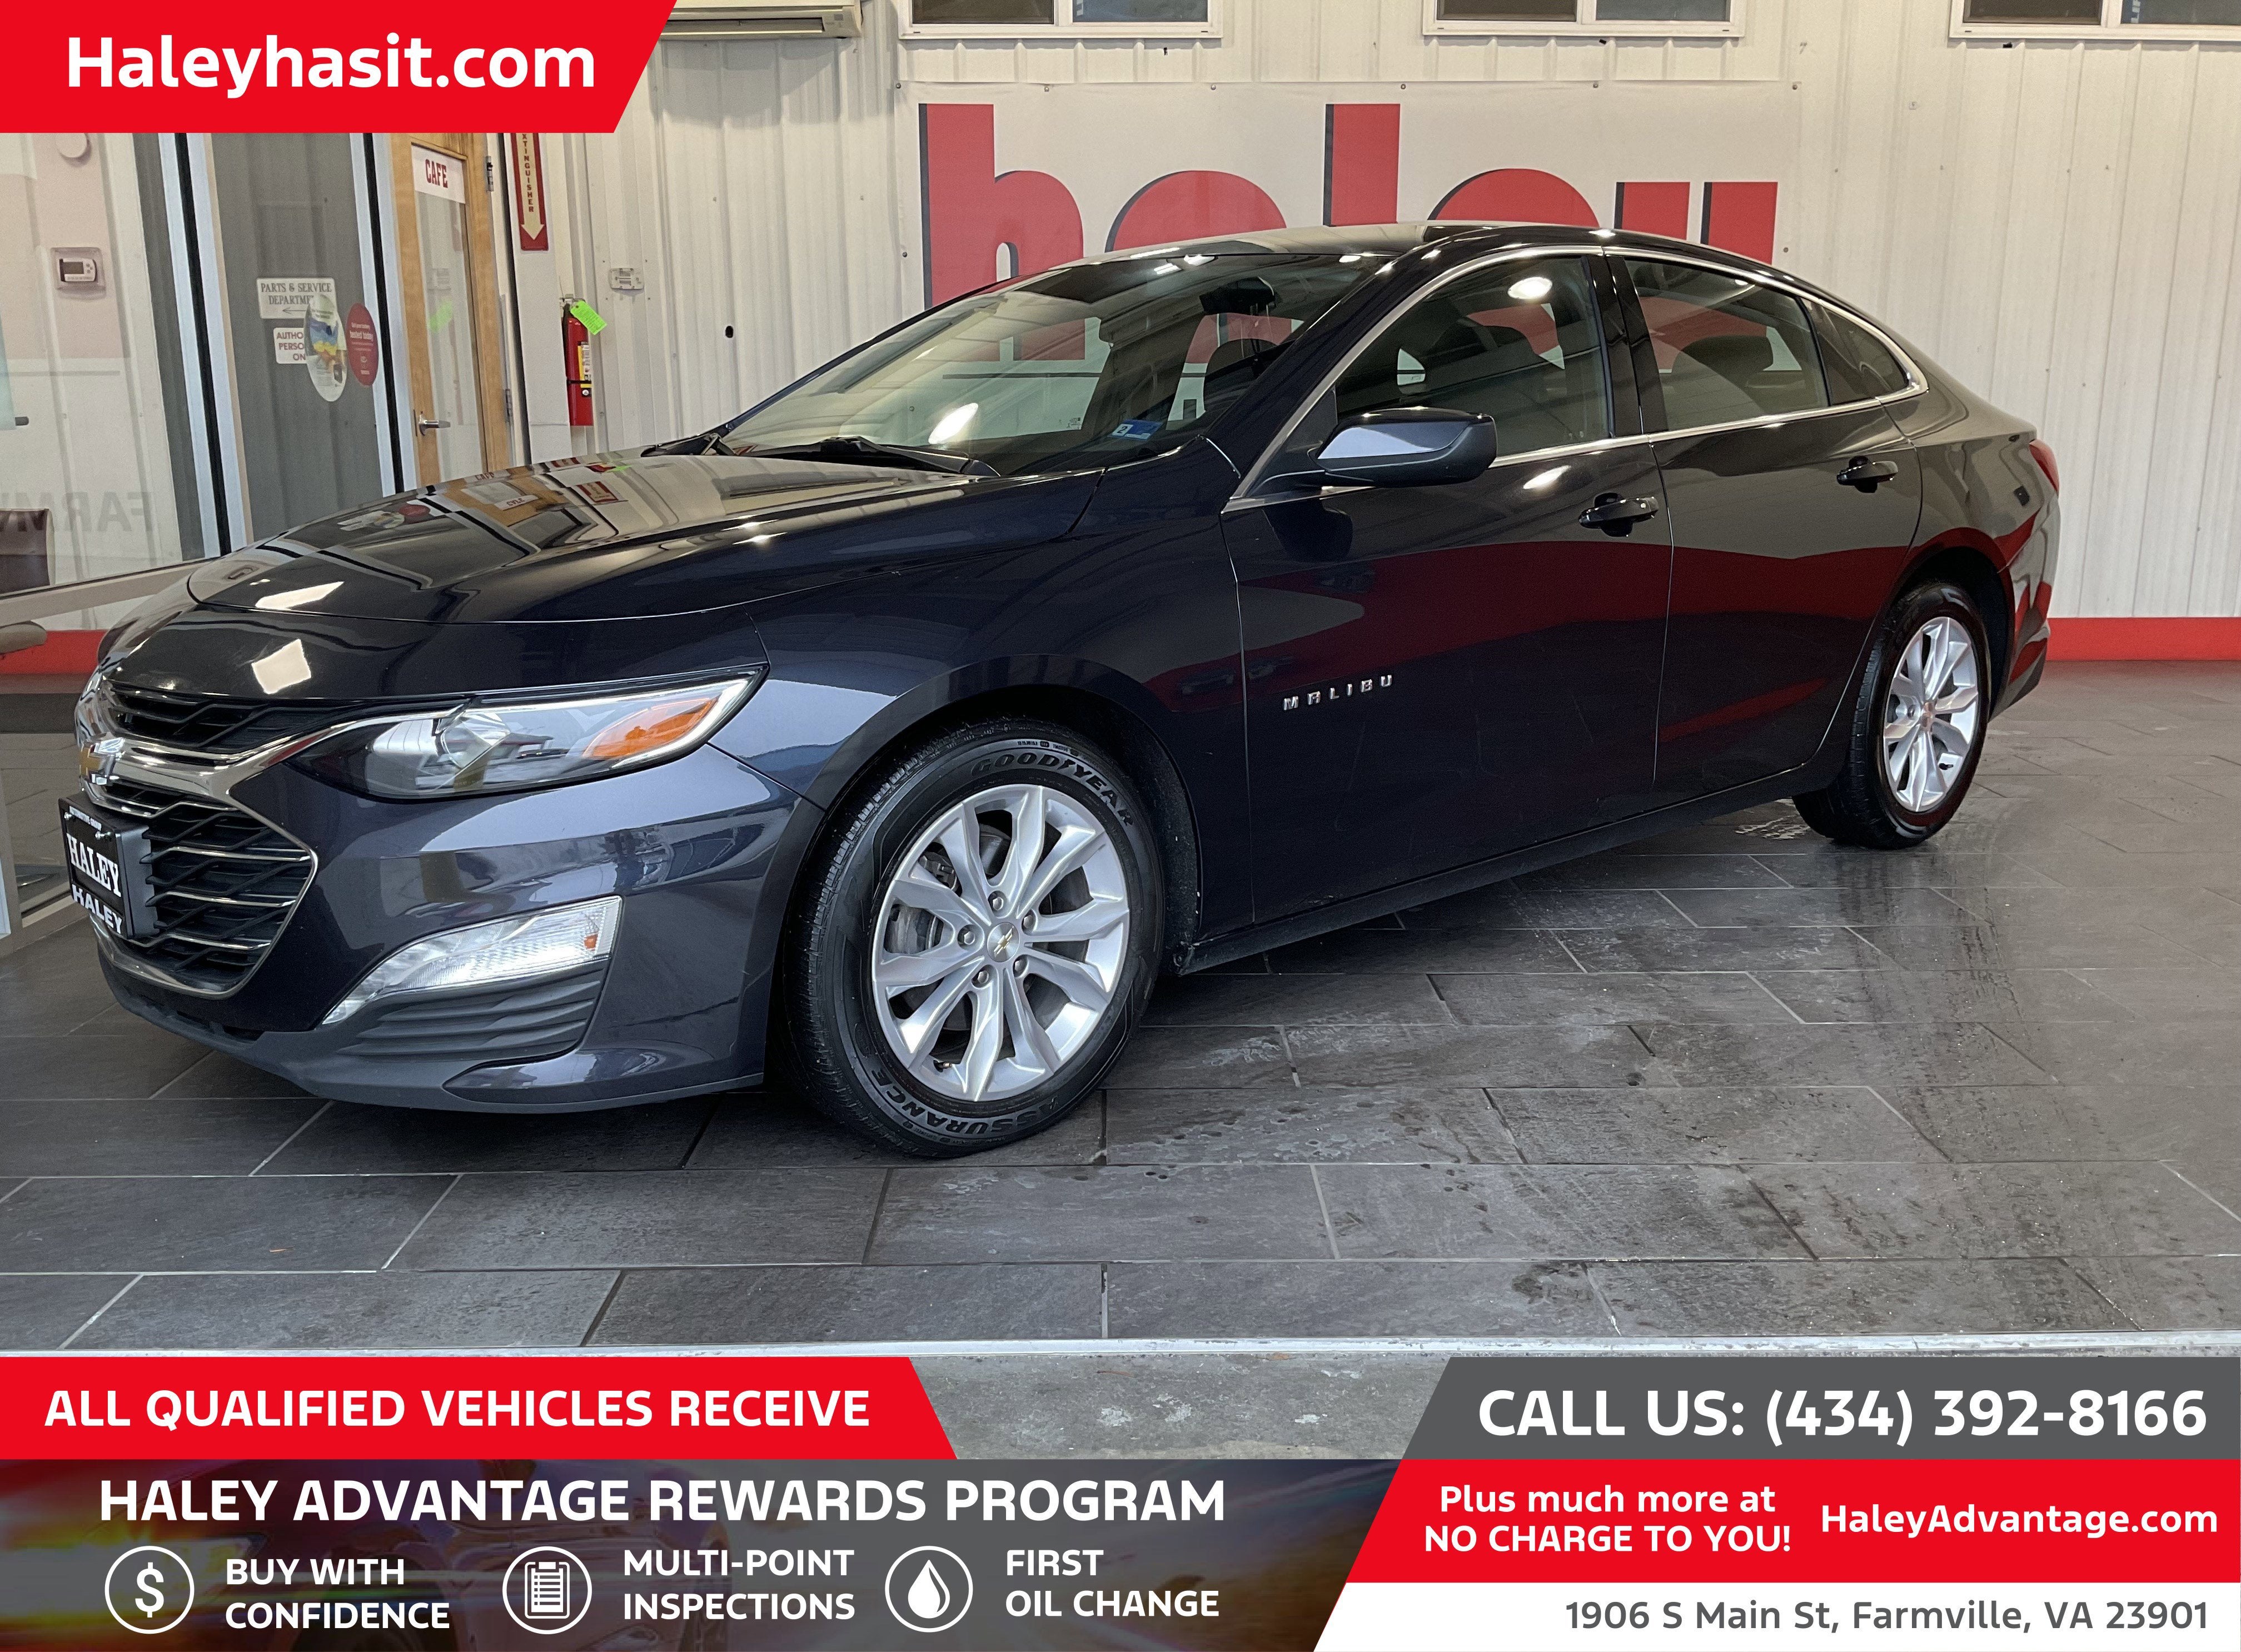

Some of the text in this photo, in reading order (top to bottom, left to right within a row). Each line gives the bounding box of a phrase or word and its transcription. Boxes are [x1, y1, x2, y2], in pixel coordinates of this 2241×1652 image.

[425, 158, 448, 188] CAFE
[522, 133, 534, 212] XTINGUISHER
[261, 282, 332, 293] PARTS & SERVICE
[292, 353, 306, 361] ON
[1117, 426, 1128, 434] 2
[1283, 674, 1392, 711] MALIBU
[971, 752, 1134, 827] GOODYEAR
[66, 833, 122, 898] HALEY
[72, 883, 122, 934] HALEY
